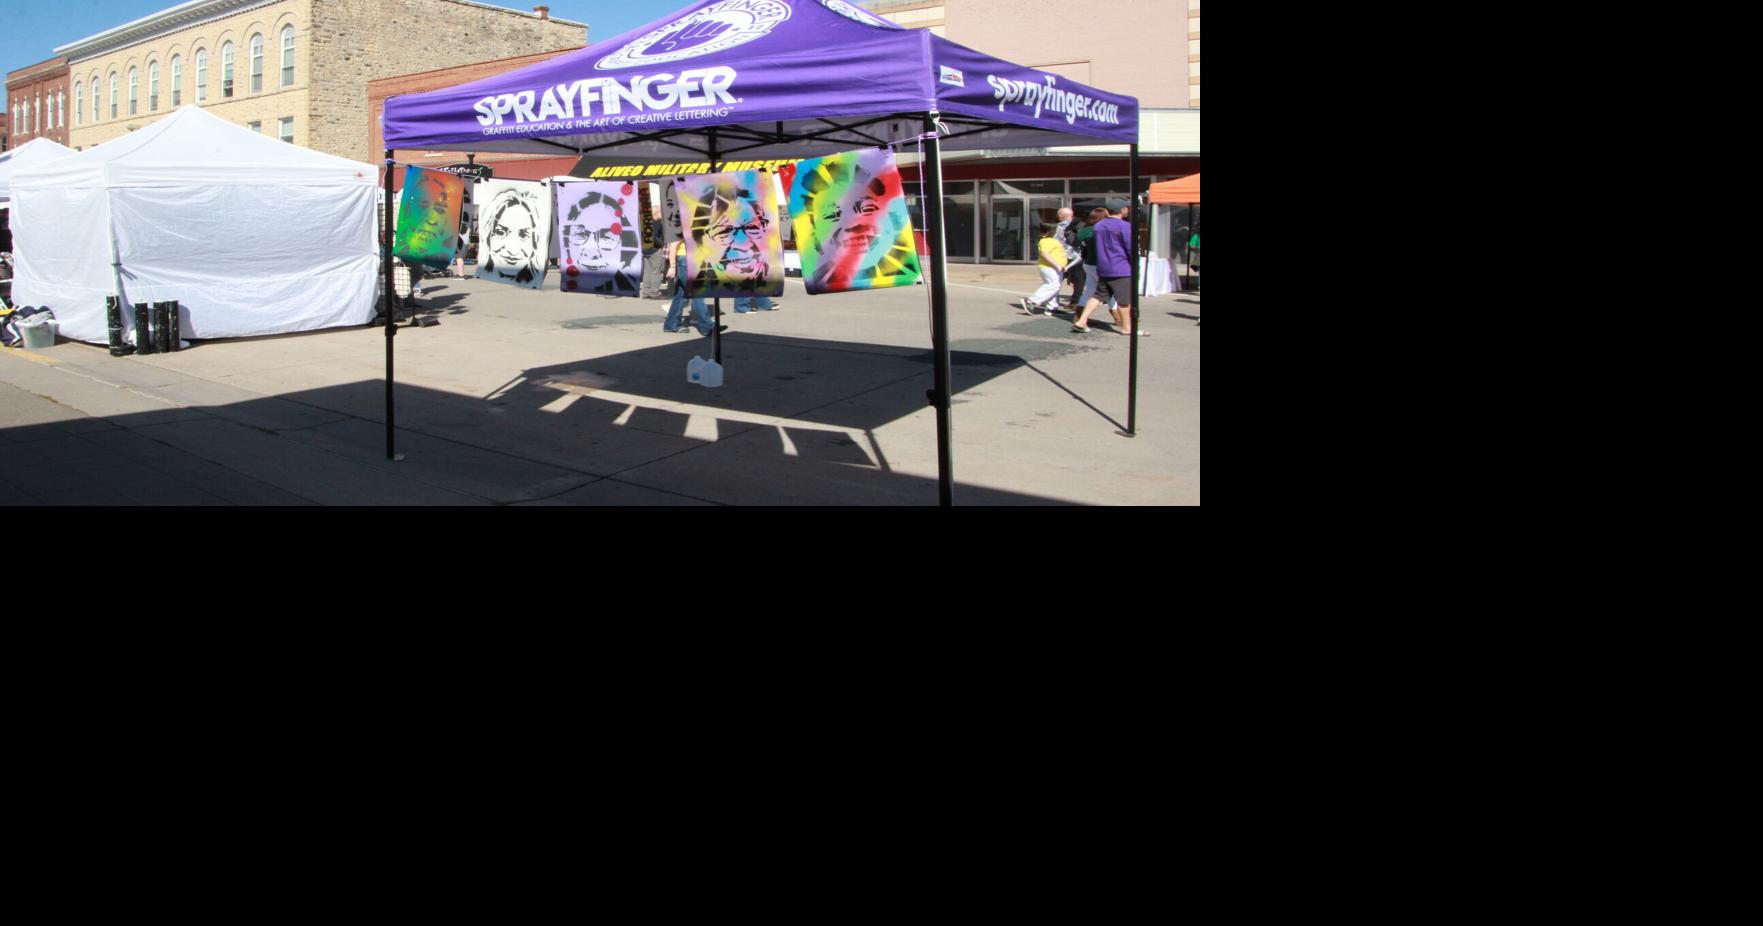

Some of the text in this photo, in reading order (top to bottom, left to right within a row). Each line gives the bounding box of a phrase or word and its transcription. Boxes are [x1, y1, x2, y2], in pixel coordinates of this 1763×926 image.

[987, 74, 1119, 125] sprayfinger.com
[482, 124, 515, 136] GRAFFITI
[516, 121, 564, 134] EDUCATION
[565, 121, 573, 130] &
[575, 118, 592, 129] THE
[593, 116, 609, 128] ART
[611, 115, 625, 126] OF
[627, 111, 673, 125] CREATIVE
[590, 164, 644, 178] ALIVEO
